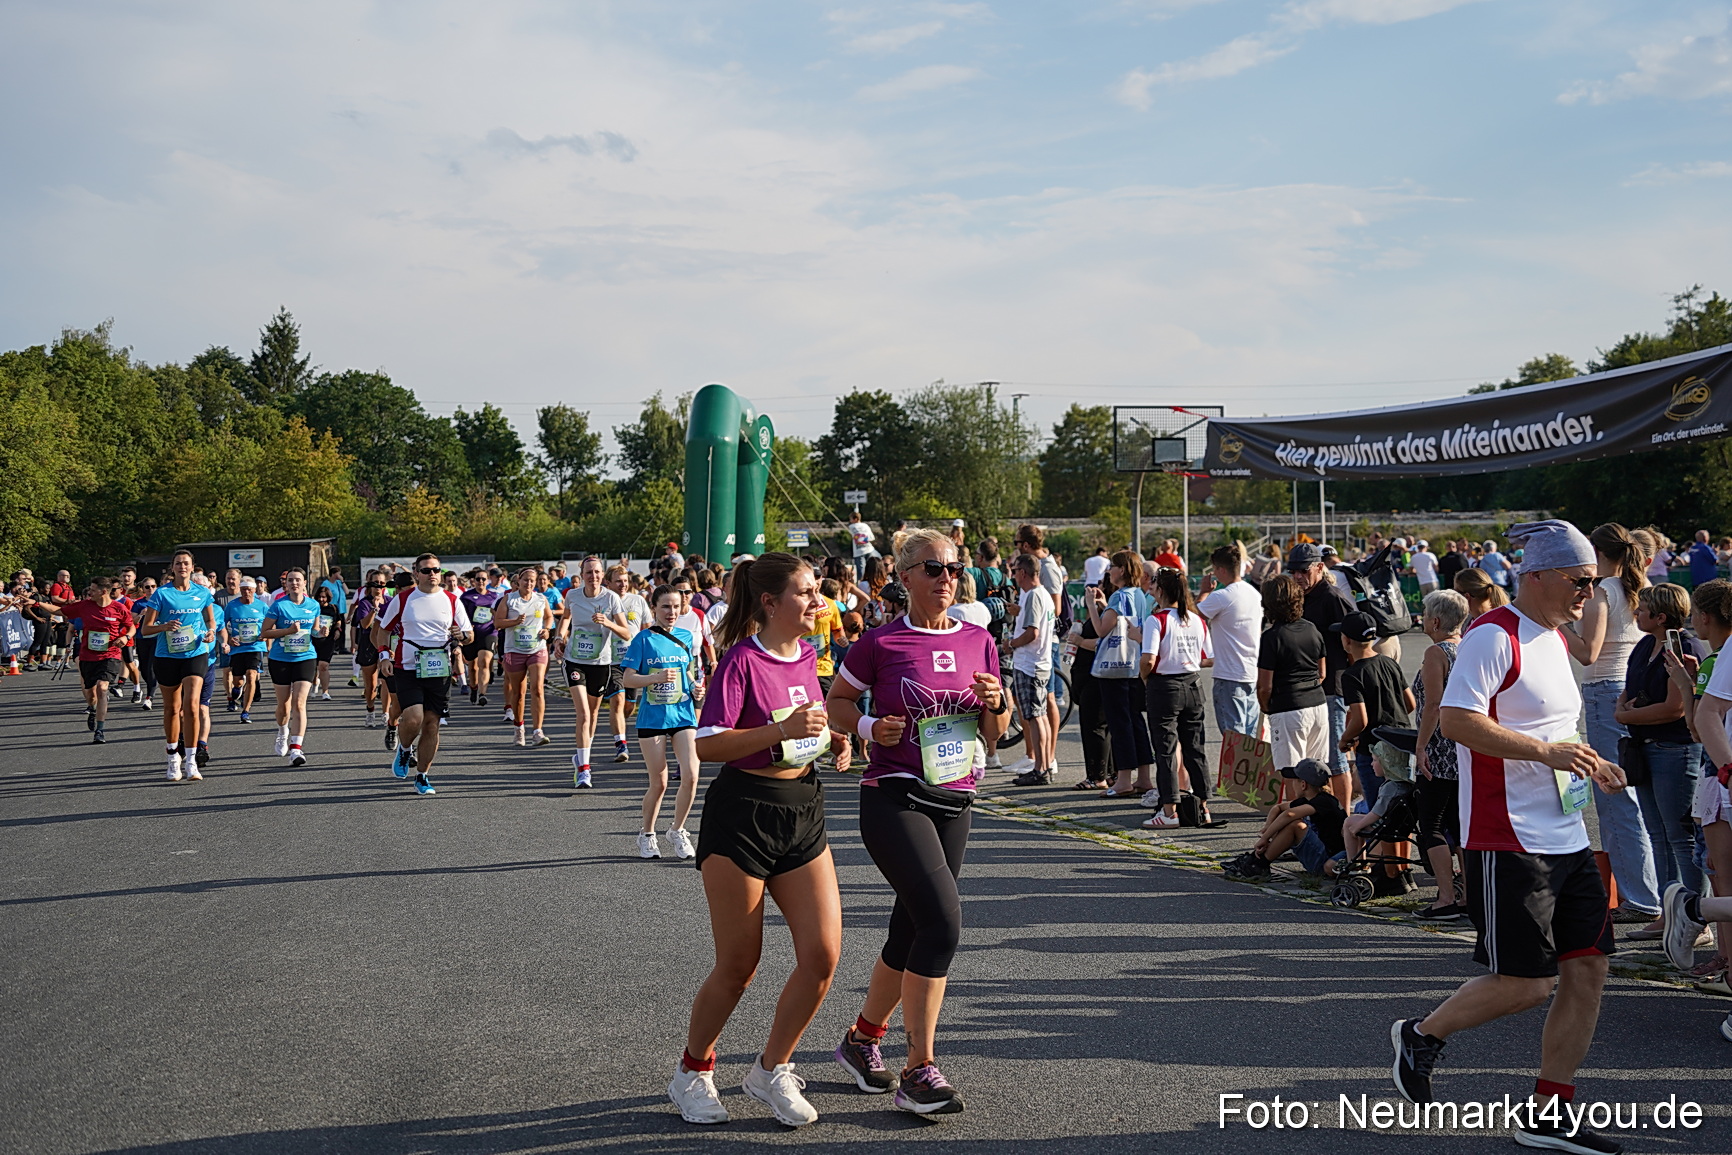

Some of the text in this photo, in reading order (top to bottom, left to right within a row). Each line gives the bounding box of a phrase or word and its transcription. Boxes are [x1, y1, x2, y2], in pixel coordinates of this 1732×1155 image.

[1652, 433, 1663, 443] Ein
[1677, 429, 1689, 439] der
[1275, 412, 1603, 475] Hier gewinnt das Miteinander.
[724, 533, 736, 545] AO
[753, 533, 765, 545] AO
[647, 655, 689, 665] RAILONE
[937, 741, 963, 758] 996
[935, 759, 955, 768] Kristina
